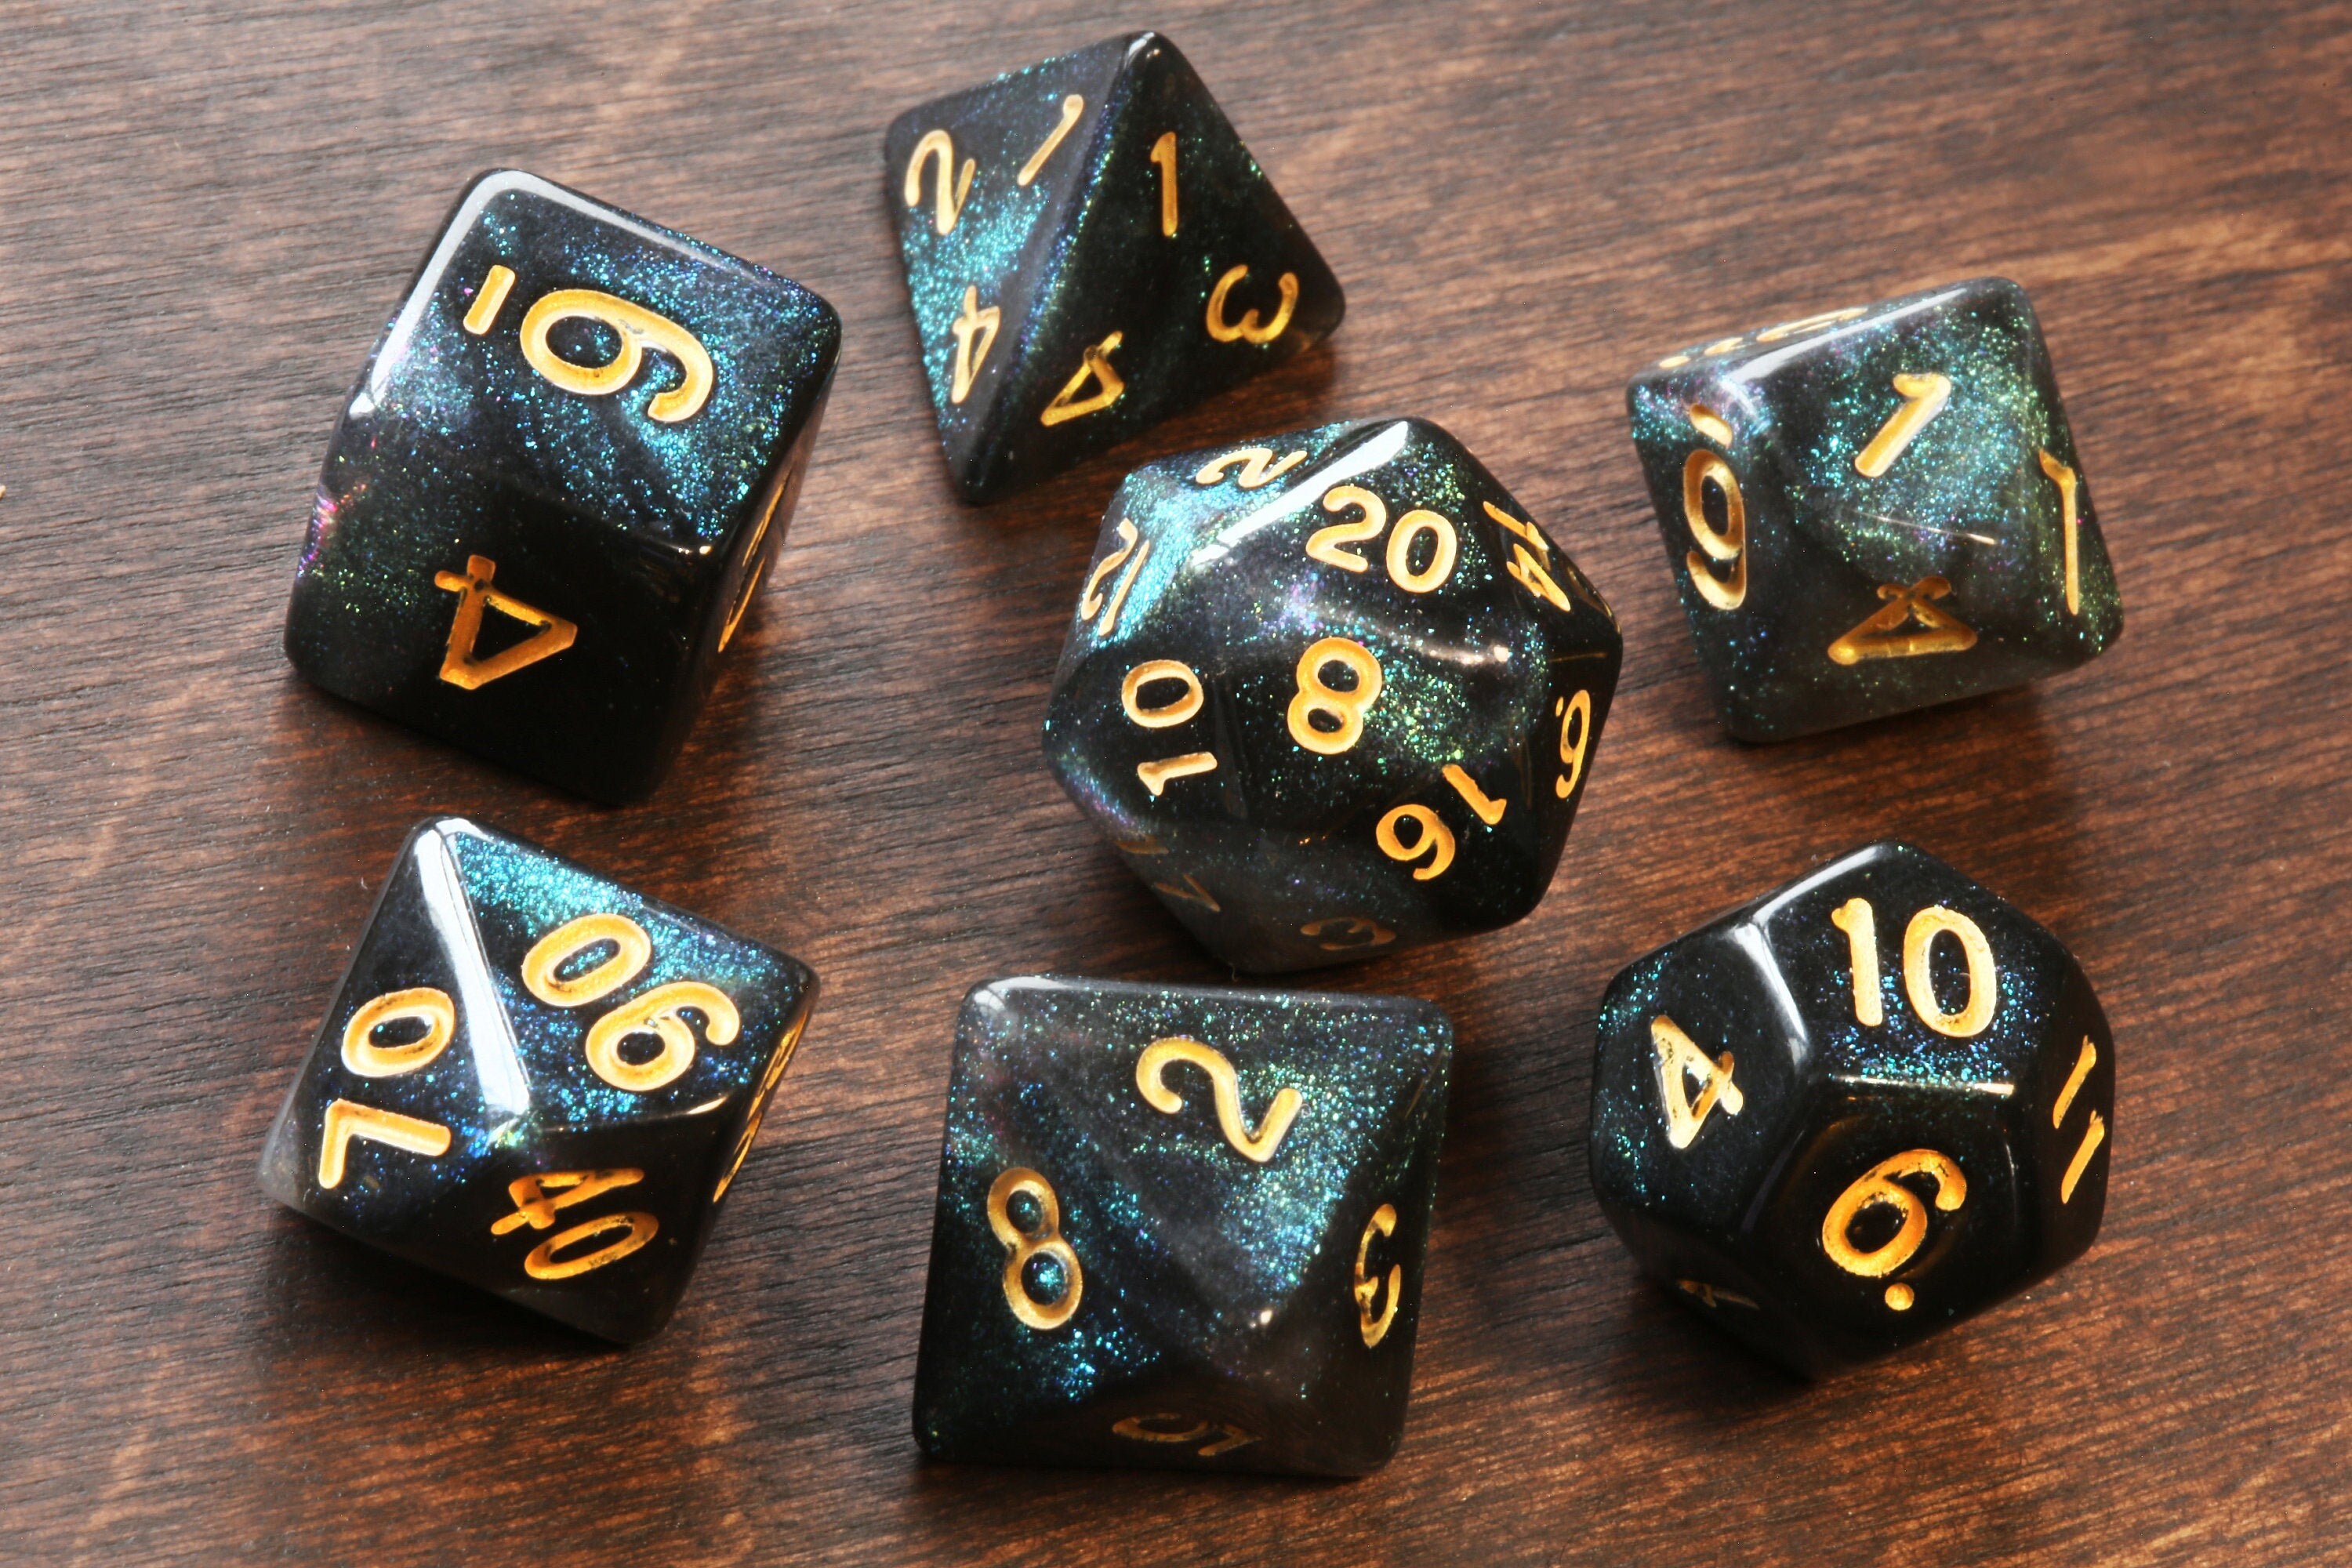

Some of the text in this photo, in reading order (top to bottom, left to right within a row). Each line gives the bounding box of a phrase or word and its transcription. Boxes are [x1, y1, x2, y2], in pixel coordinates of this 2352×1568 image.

[1149, 131, 1178, 237] 1
[953, 285, 1001, 405] 4
[1206, 264, 1299, 345] 3
[1040, 331, 1125, 426] 4
[1195, 447, 1308, 488] 2
[1305, 485, 1457, 593] 20
[434, 555, 578, 691] 4
[1828, 577, 1977, 666] 4
[1121, 659, 1218, 797] 10
[1287, 636, 1384, 755] 8
[1376, 764, 1507, 880] 16
[1831, 898, 1997, 1039] 10
[318, 987, 456, 1189] 70
[1135, 1036, 1301, 1163] 2
[1650, 1015, 1744, 1149] 4
[491, 1168, 659, 1279] 40
[987, 1167, 1083, 1330] 8
